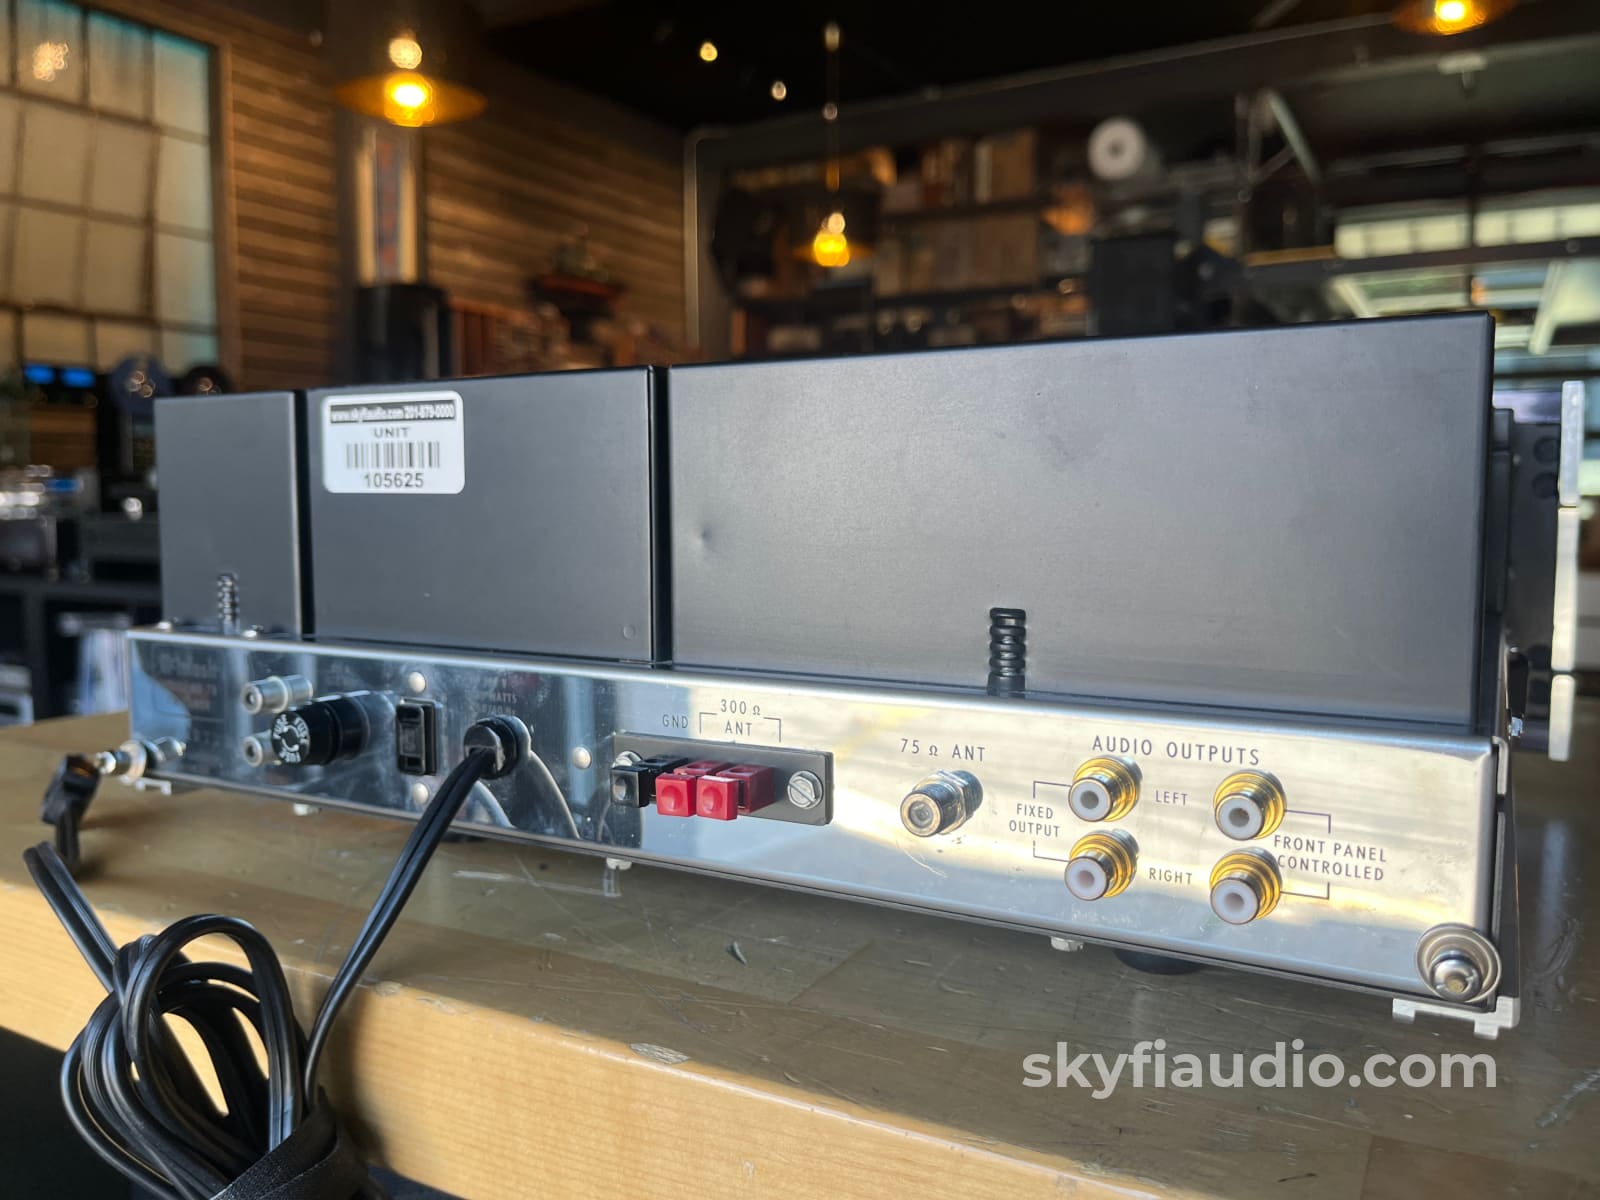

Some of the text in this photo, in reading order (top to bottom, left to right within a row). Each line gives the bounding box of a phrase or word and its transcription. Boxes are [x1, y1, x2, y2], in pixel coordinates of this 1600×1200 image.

[373, 426, 409, 438] UNIT
[364, 472, 424, 488] 105625
[720, 699, 747, 715] 300
[662, 714, 689, 729] GND
[724, 720, 753, 736] ANT
[901, 738, 920, 754] 75
[952, 744, 986, 762] ANT
[1092, 735, 1260, 766] AUDIO OUTPUTS
[1155, 790, 1188, 806] LEFT
[1016, 803, 1053, 820] FIXED
[1009, 819, 1061, 838] OUTPUT
[1273, 834, 1387, 863] FRONT PANEL
[1149, 867, 1193, 885] RIGHT
[1276, 854, 1384, 882] CONTROLLED
